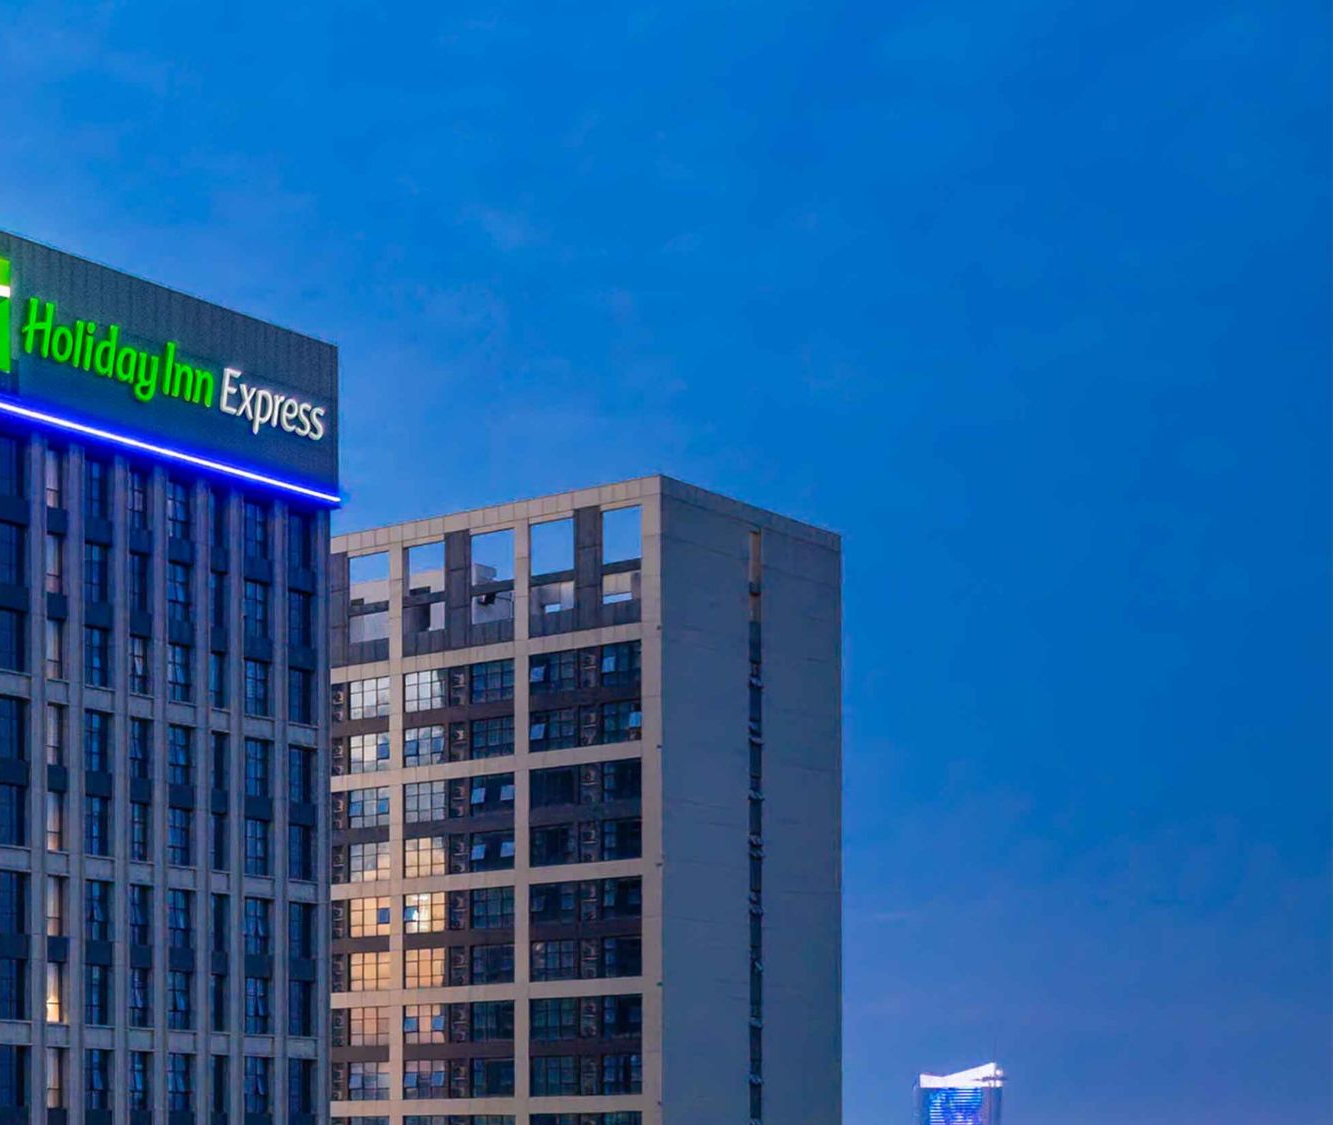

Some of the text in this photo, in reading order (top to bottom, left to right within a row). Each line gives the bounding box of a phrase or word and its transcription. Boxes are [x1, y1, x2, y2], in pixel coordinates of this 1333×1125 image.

[22, 297, 327, 441] Holiday Inn Express
